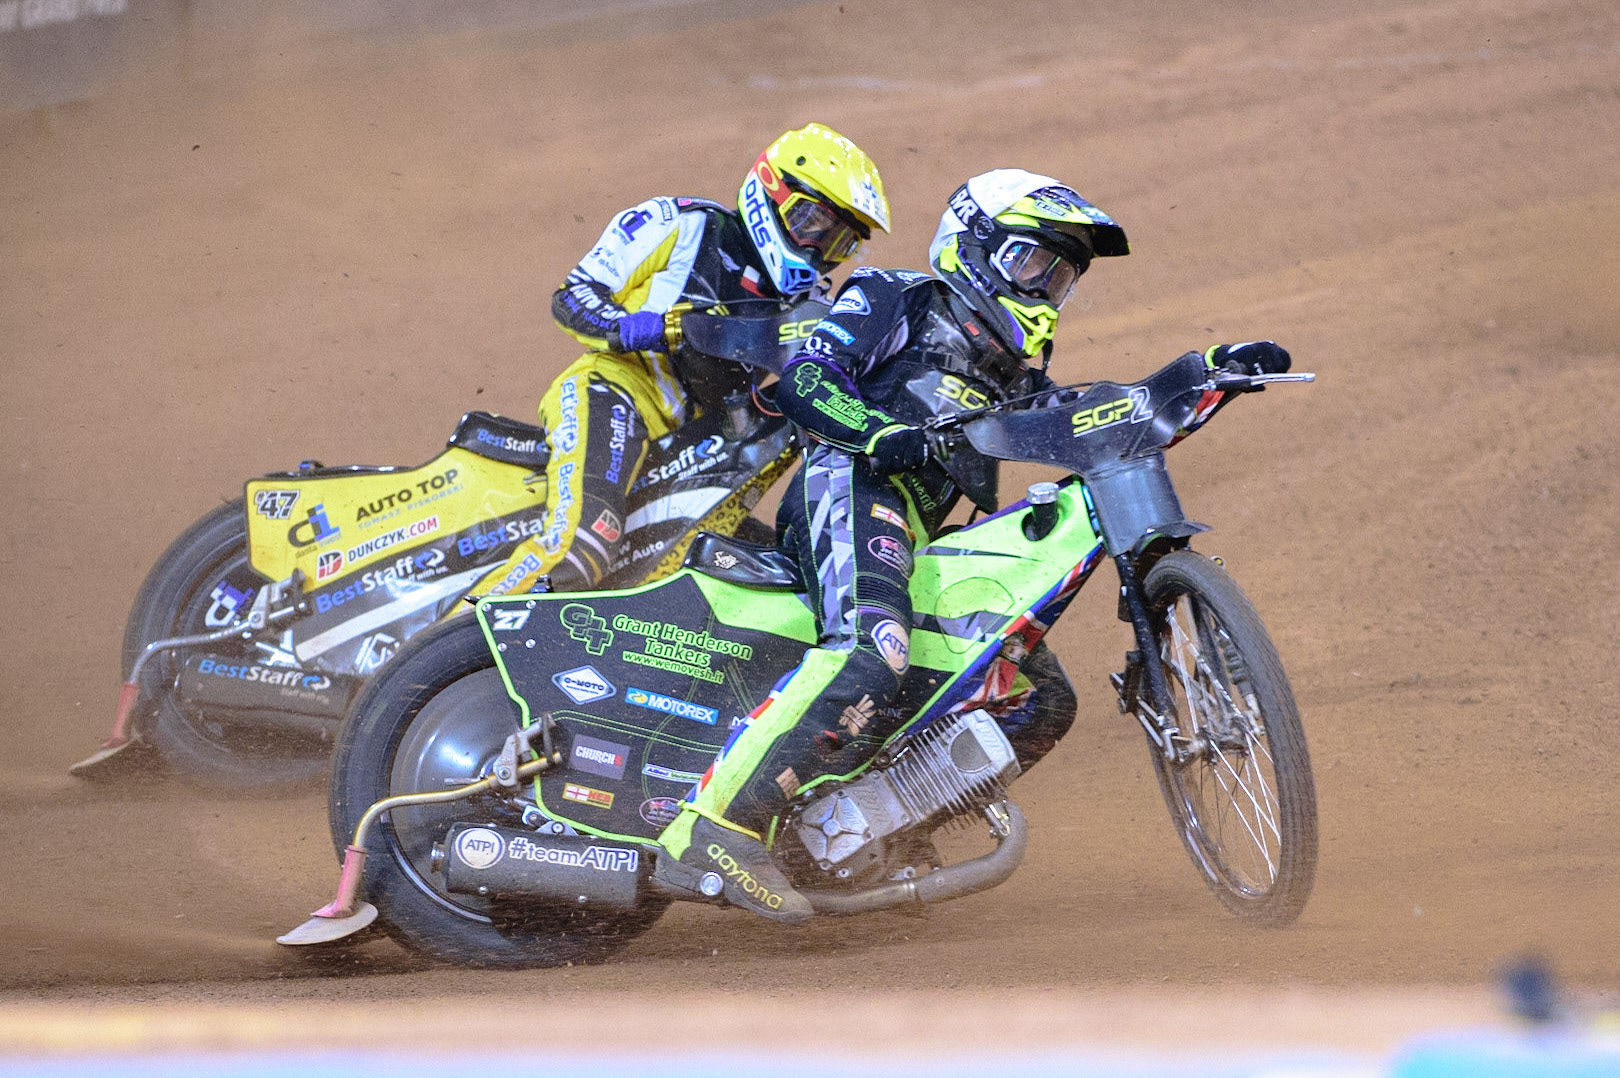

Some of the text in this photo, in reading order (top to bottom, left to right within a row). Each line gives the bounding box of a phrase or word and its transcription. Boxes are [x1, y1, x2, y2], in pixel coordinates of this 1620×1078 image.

[745, 178, 772, 249] ortis
[1071, 386, 1154, 434] SGP2
[476, 428, 537, 453] BestStaff
[604, 417, 627, 485] BestStaff
[677, 463, 699, 481] Staff
[698, 456, 717, 472] with
[355, 468, 458, 522] AUTO TOP
[347, 516, 438, 563] DUNCZYK.COM
[632, 540, 665, 563] Auto
[315, 554, 414, 614] BestStaff
[612, 614, 753, 661] Grant Henderson
[644, 637, 712, 667] Tankers
[198, 658, 304, 688] BestStaff
[622, 650, 725, 685] www.wemovesh.it
[647, 693, 716, 724] MOTOREX
[464, 839, 496, 854] ATPI
[508, 837, 641, 873] #teamATPI
[706, 842, 784, 911] daytona
